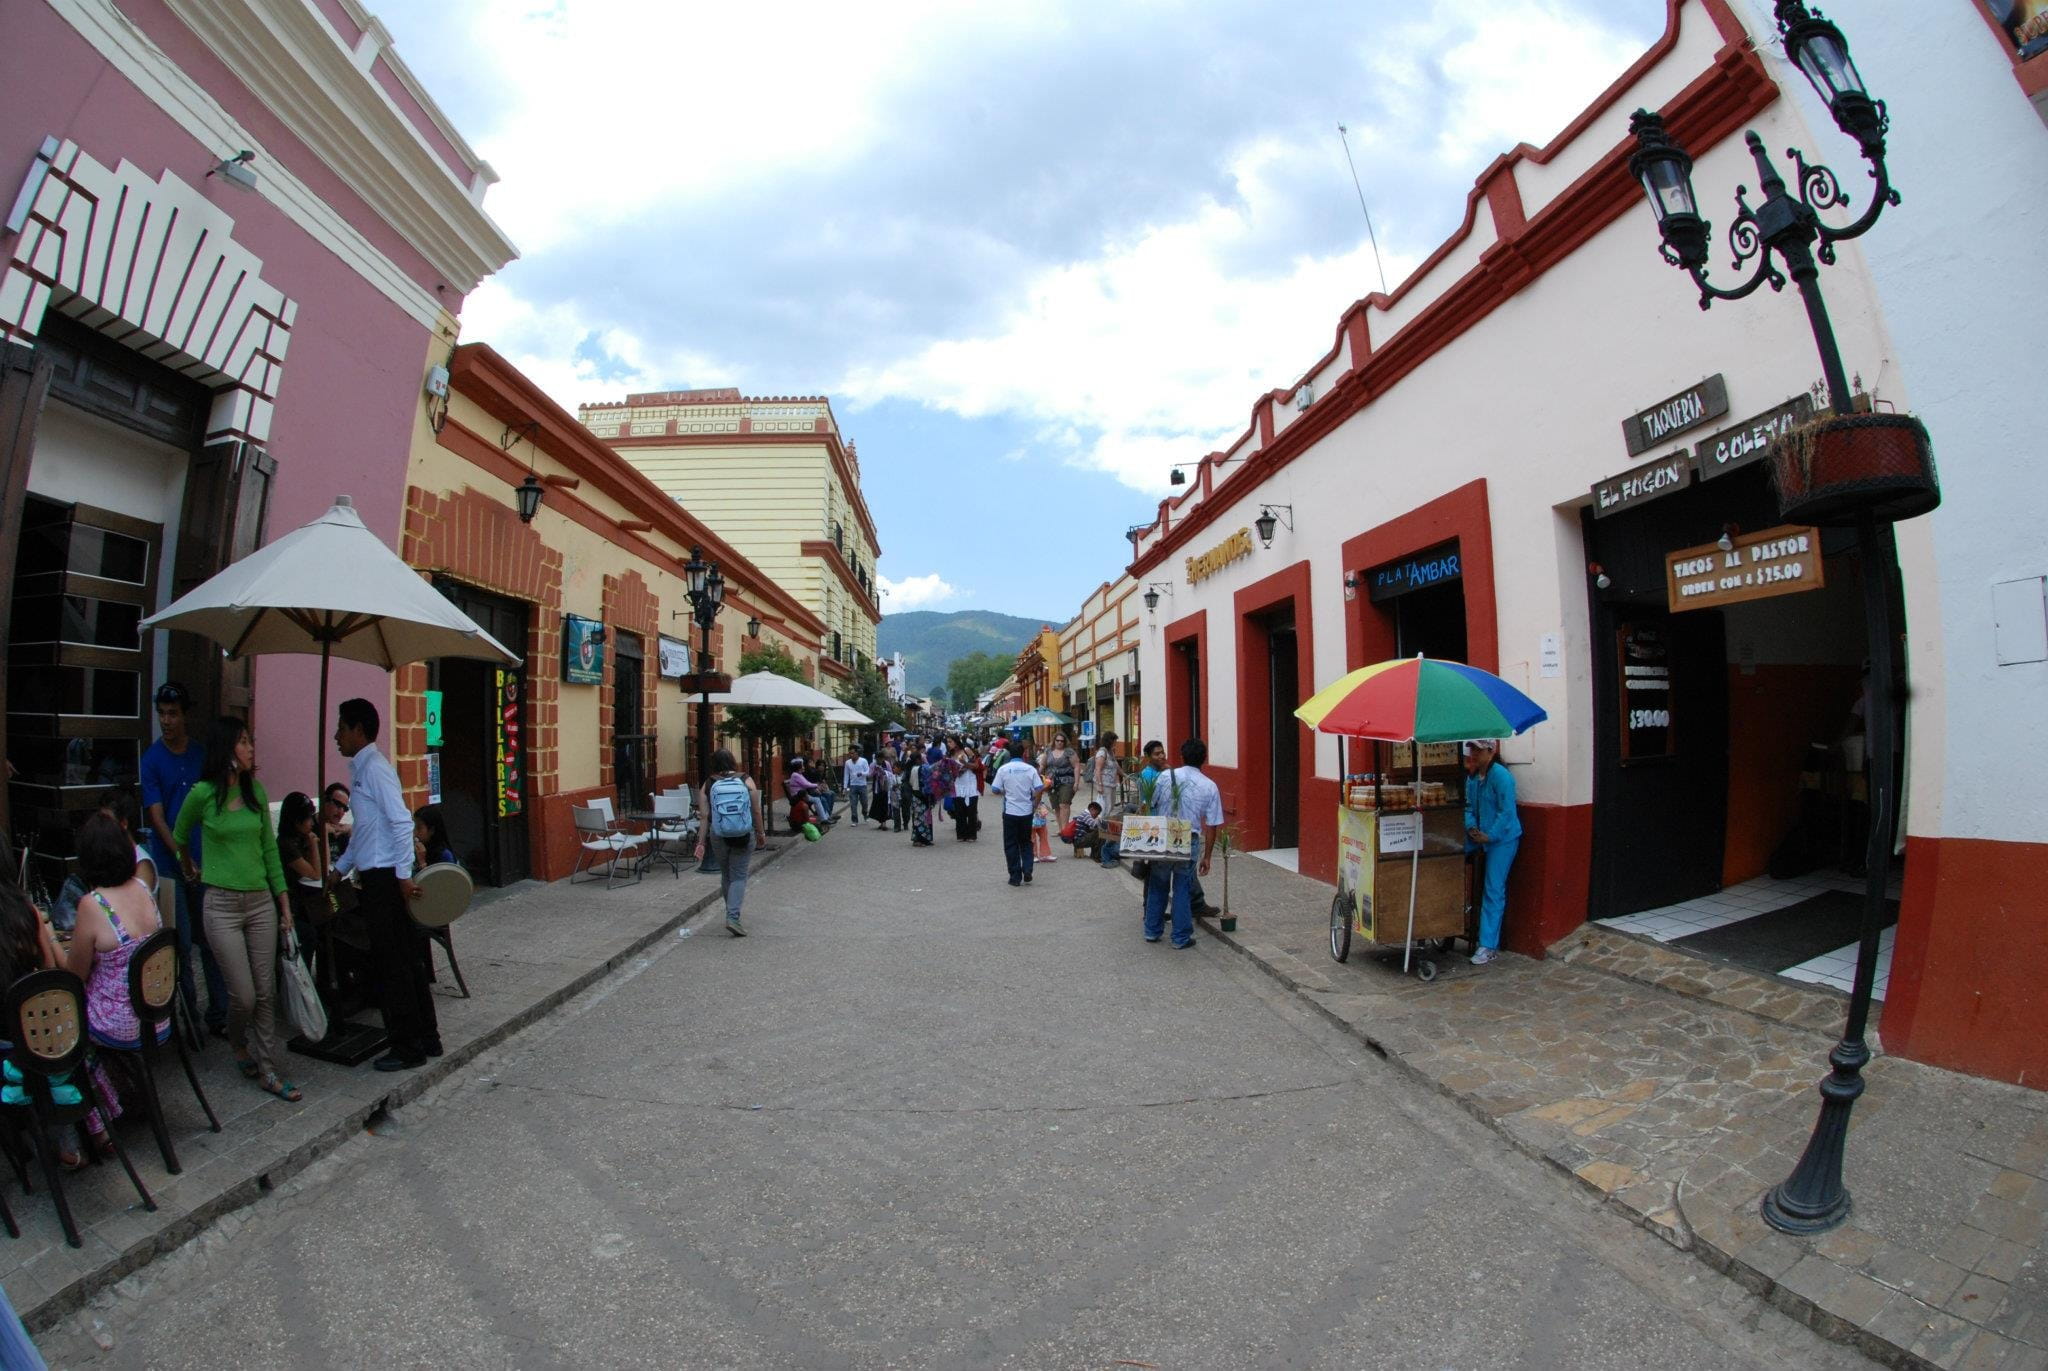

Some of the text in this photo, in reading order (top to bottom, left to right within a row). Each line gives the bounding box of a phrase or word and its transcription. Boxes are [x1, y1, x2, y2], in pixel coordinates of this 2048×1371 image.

[1600, 486, 1619, 509] EL
[1674, 536, 1809, 578] TACOS AL PASTOR
[1681, 580, 1715, 596] ORDEN
[1720, 575, 1742, 589] CON
[496, 669, 506, 818] BILLARES
